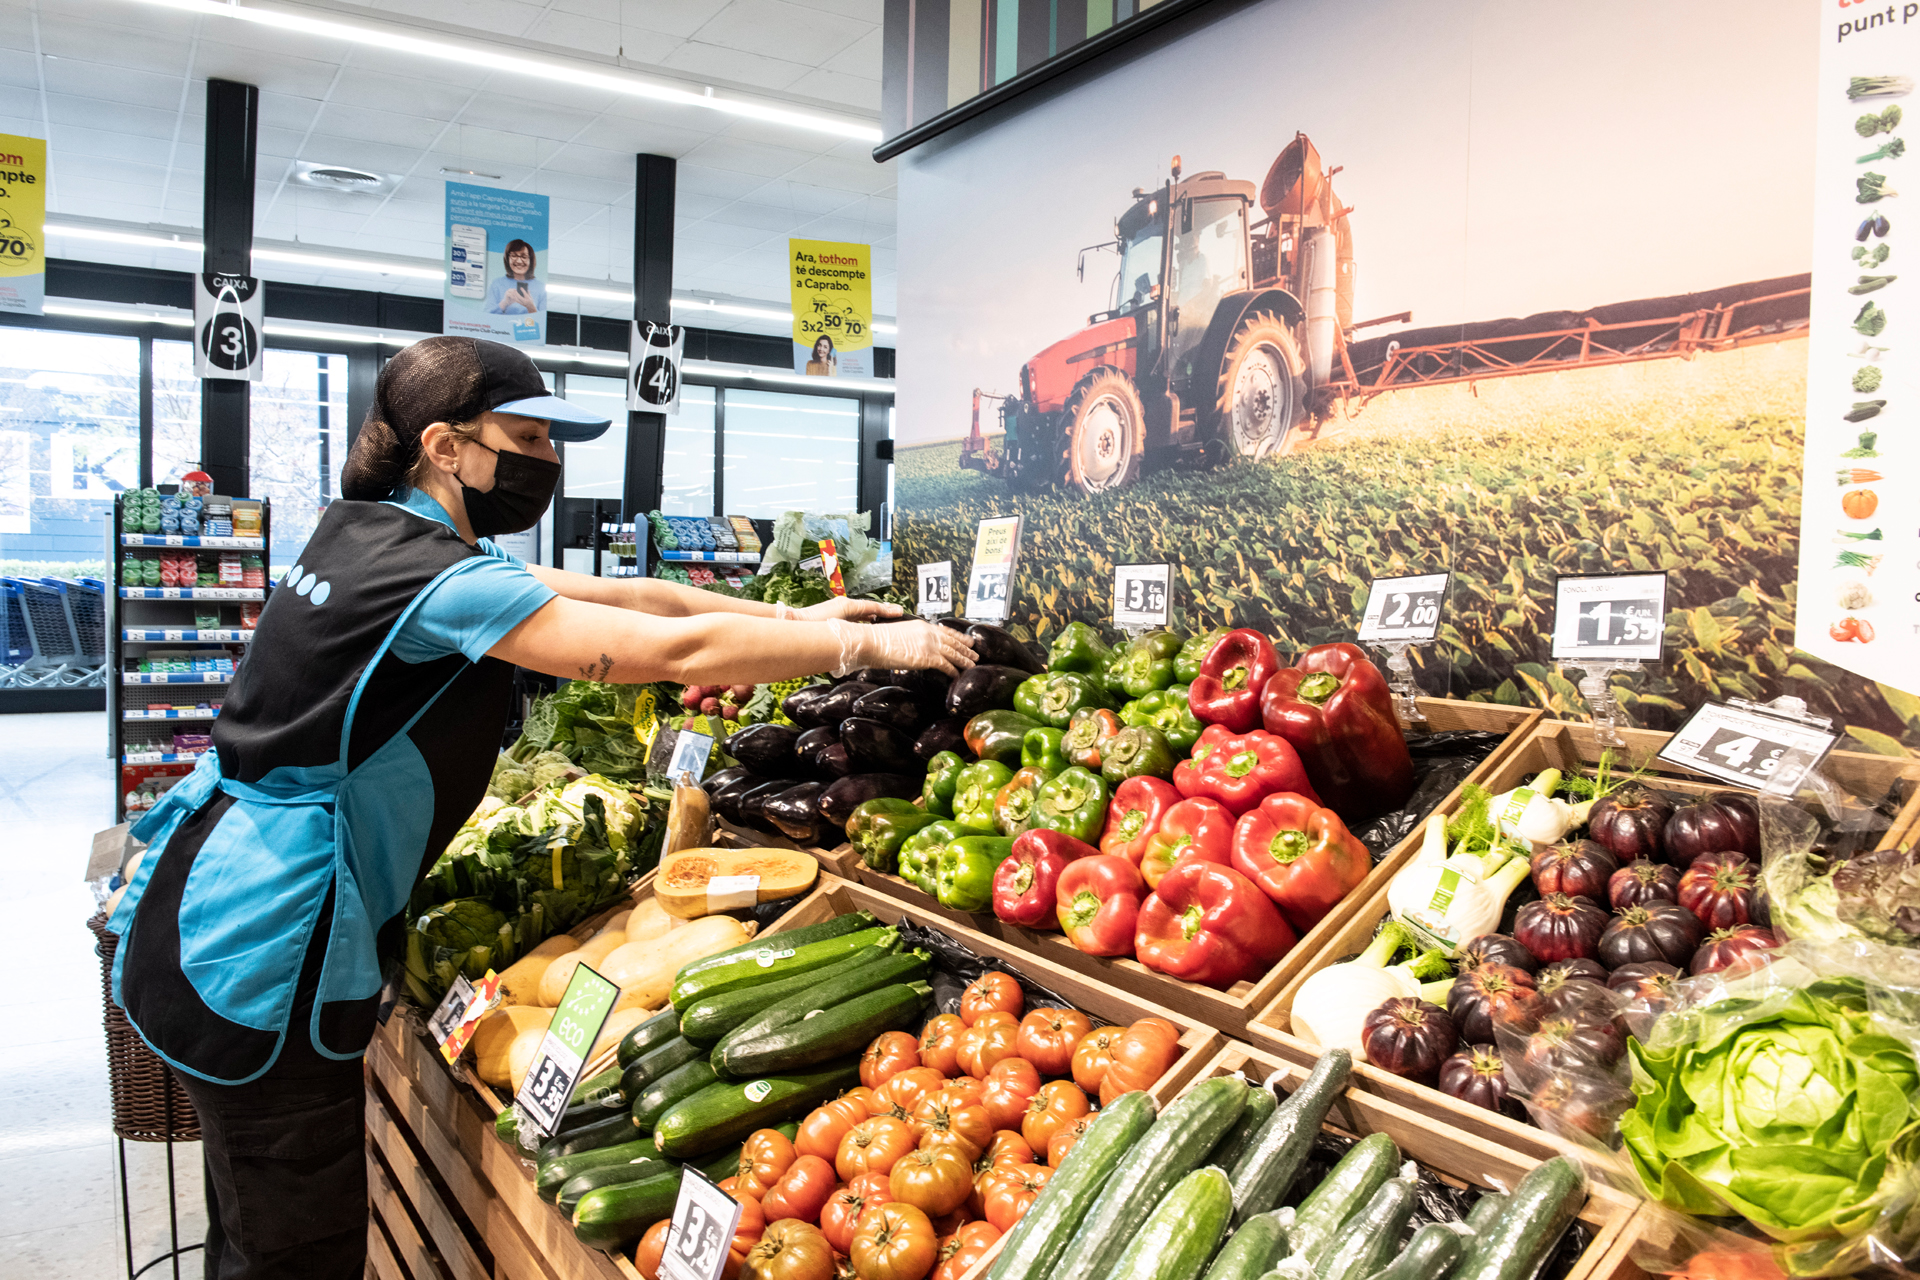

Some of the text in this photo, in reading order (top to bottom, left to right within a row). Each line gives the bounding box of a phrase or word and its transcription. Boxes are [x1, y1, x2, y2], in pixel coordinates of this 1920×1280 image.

[1838, 3, 1920, 43] punt p
[482, 194, 508, 203] Caprabo
[501, 204, 516, 212] Club
[516, 207, 542, 216] Caprabo
[796, 251, 858, 266] Ara, tothom
[796, 265, 865, 280] té descompte
[213, 277, 248, 290] CAIXA
[805, 278, 852, 291] Caprabo.
[801, 320, 823, 332] 3x2
[220, 326, 242, 355] 3
[648, 368, 665, 393] 4
[988, 527, 1006, 536] Preus
[985, 545, 1003, 554] bons!
[1385, 593, 1437, 628] 2,00
[1589, 602, 1656, 644] 1,55
[559, 1016, 584, 1047] eco
[533, 1059, 563, 1112] 3,35
[748, 1086, 761, 1099] BIO
[681, 1206, 716, 1274] 3,29
